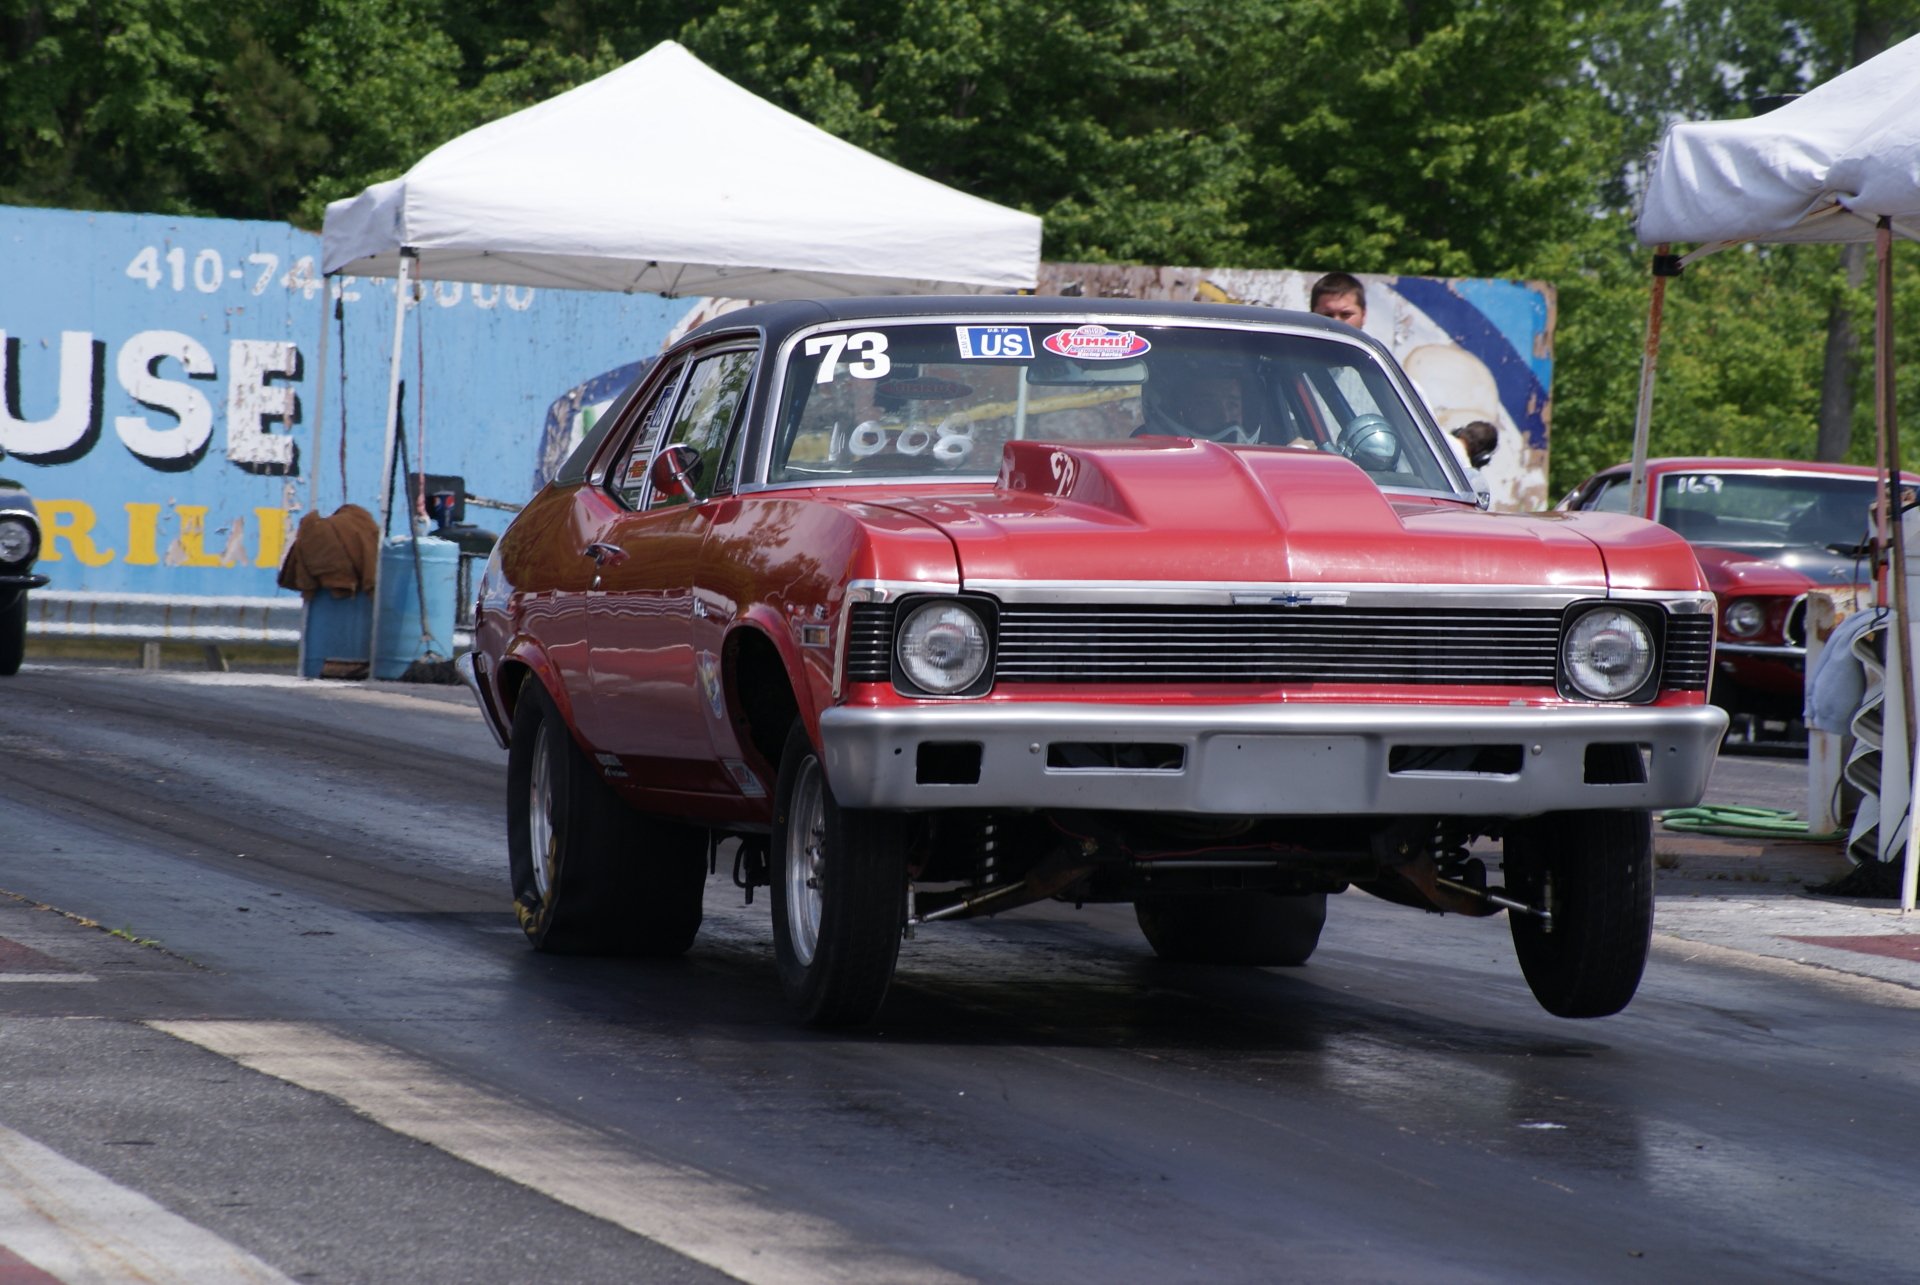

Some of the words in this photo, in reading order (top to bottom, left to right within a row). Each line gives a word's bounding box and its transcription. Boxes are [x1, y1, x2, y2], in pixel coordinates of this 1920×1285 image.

[805, 331, 891, 384] 73
[981, 334, 1023, 356] US
[0, 329, 303, 472] USE
[1677, 475, 1723, 494] 169
